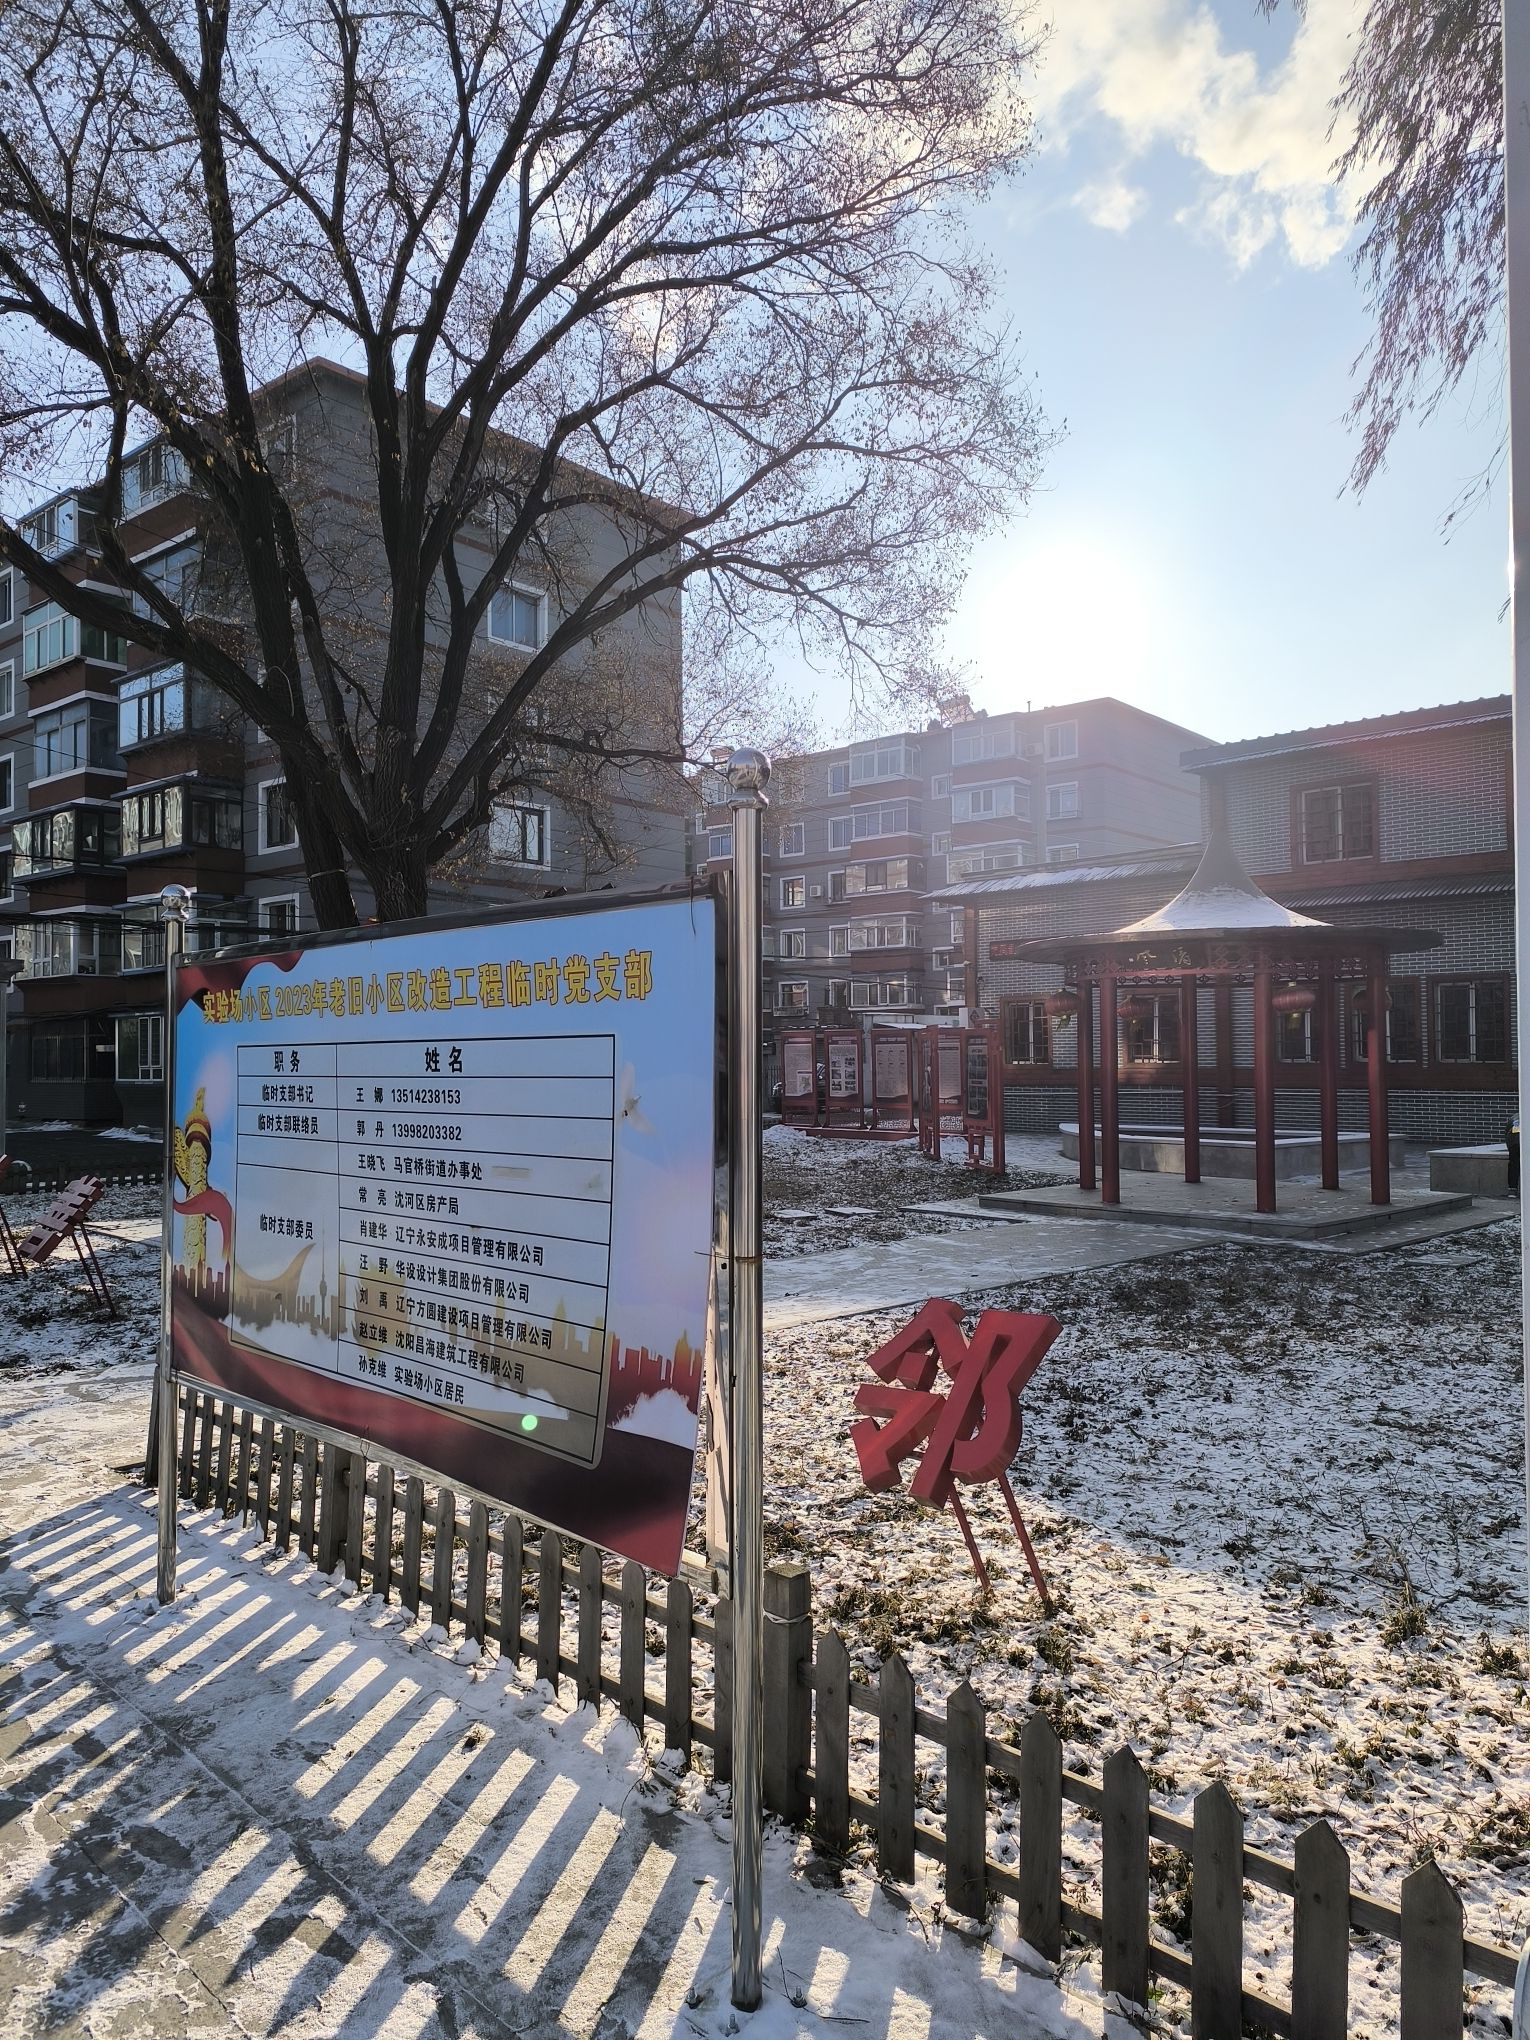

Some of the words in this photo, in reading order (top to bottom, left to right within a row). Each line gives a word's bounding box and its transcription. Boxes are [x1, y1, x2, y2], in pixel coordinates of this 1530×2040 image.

[202, 985, 272, 1025] 实验场小区
[275, 948, 653, 1018] 2023年老旧小区改造工程临时党支部
[274, 1049, 300, 1073] 职务
[424, 1045, 463, 1073] 姓名
[261, 1084, 314, 1103] 临时支部书记
[391, 1088, 461, 1105] 13514238153
[257, 1113, 319, 1135] 临时支部联络员
[392, 1123, 462, 1141] 13998203382
[358, 1153, 386, 1172] 王晓飞
[393, 1156, 483, 1181] 马官桥街道办事处
[394, 1190, 460, 1216] 沈河区房产局
[259, 1213, 314, 1240] 临时支部委员
[359, 1219, 388, 1241] 肖建华
[395, 1225, 545, 1267] 辽宁永安成项目管理有限公司
[395, 1259, 530, 1304] 华设设计集团股份有限公司
[395, 1294, 553, 1350] 辽宁方圆建设项目管理有限公司
[394, 1330, 525, 1385] 沈阳昌海建筑工程有限公司
[394, 1364, 465, 1406] 实验场小区居民
